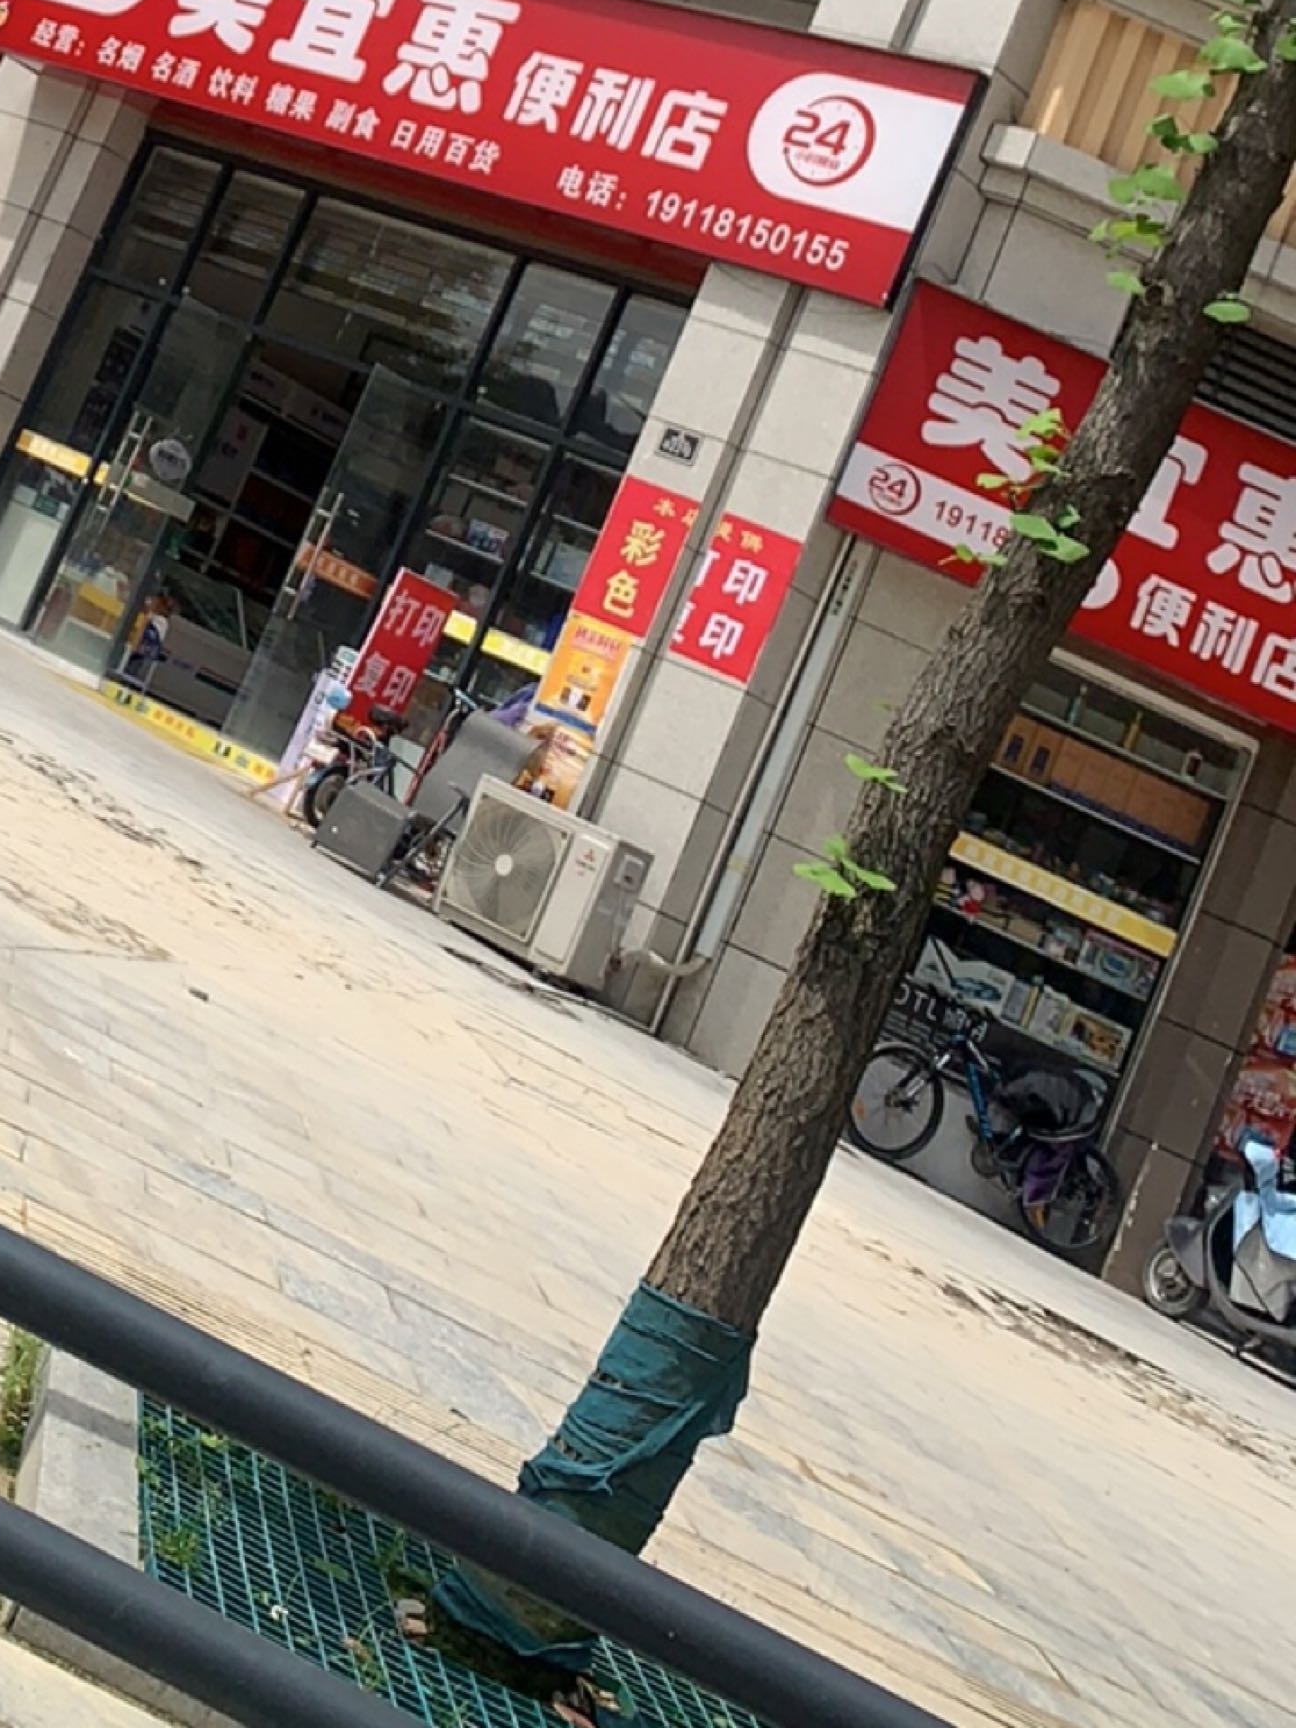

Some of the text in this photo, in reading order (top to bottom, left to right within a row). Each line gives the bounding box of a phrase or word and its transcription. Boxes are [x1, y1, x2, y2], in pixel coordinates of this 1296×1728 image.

[503, 50, 728, 171] 便利店
[783, 109, 850, 155] 24
[390, 119, 501, 175] 日用百货
[647, 189, 850, 271] 19118150155
[868, 466, 908, 498] 24
[602, 519, 666, 620] 彩色
[386, 588, 447, 648] 打印
[354, 651, 417, 707] 复印
